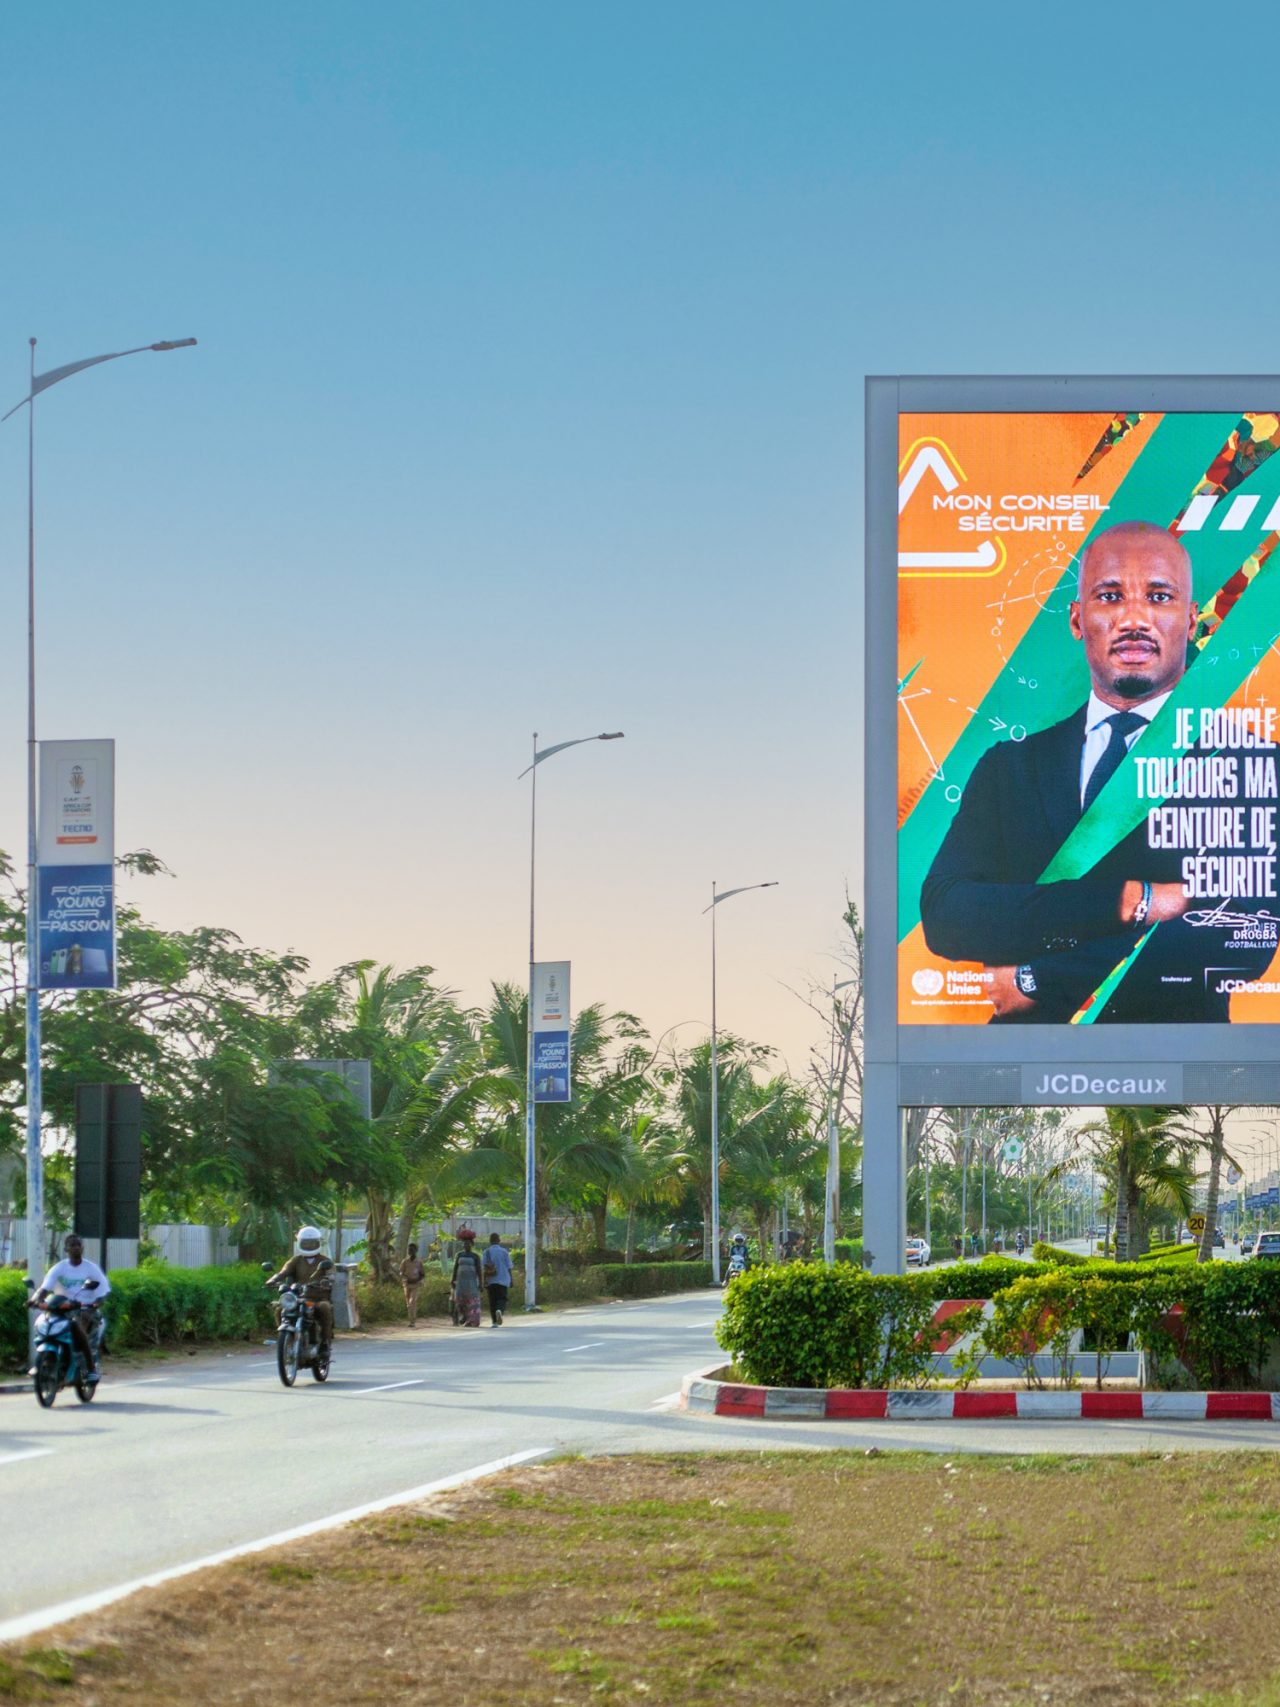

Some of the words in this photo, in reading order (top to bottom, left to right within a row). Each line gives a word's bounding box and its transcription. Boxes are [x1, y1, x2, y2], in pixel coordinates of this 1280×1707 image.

[933, 495, 992, 510] MON
[1000, 494, 1110, 511] CONSEIL
[958, 512, 1085, 532] SÉCURITÉ
[1172, 707, 1194, 750] JE
[1200, 707, 1277, 750] BOUCLE
[1133, 756, 1238, 799] TOUJOURS
[1244, 756, 1278, 799] MA
[1148, 806, 1245, 849] CEINTURE
[1250, 806, 1277, 849] DE
[1181, 846, 1277, 898] SÉCURITÉ
[56, 896, 106, 908] YOUNG
[49, 920, 111, 932] PASSION
[1233, 930, 1277, 940] DROGBA
[947, 970, 994, 983] Nations
[946, 984, 981, 995] Unies
[1036, 1074, 1168, 1094] JCDecaux
[1190, 1218, 1204, 1230] 20
